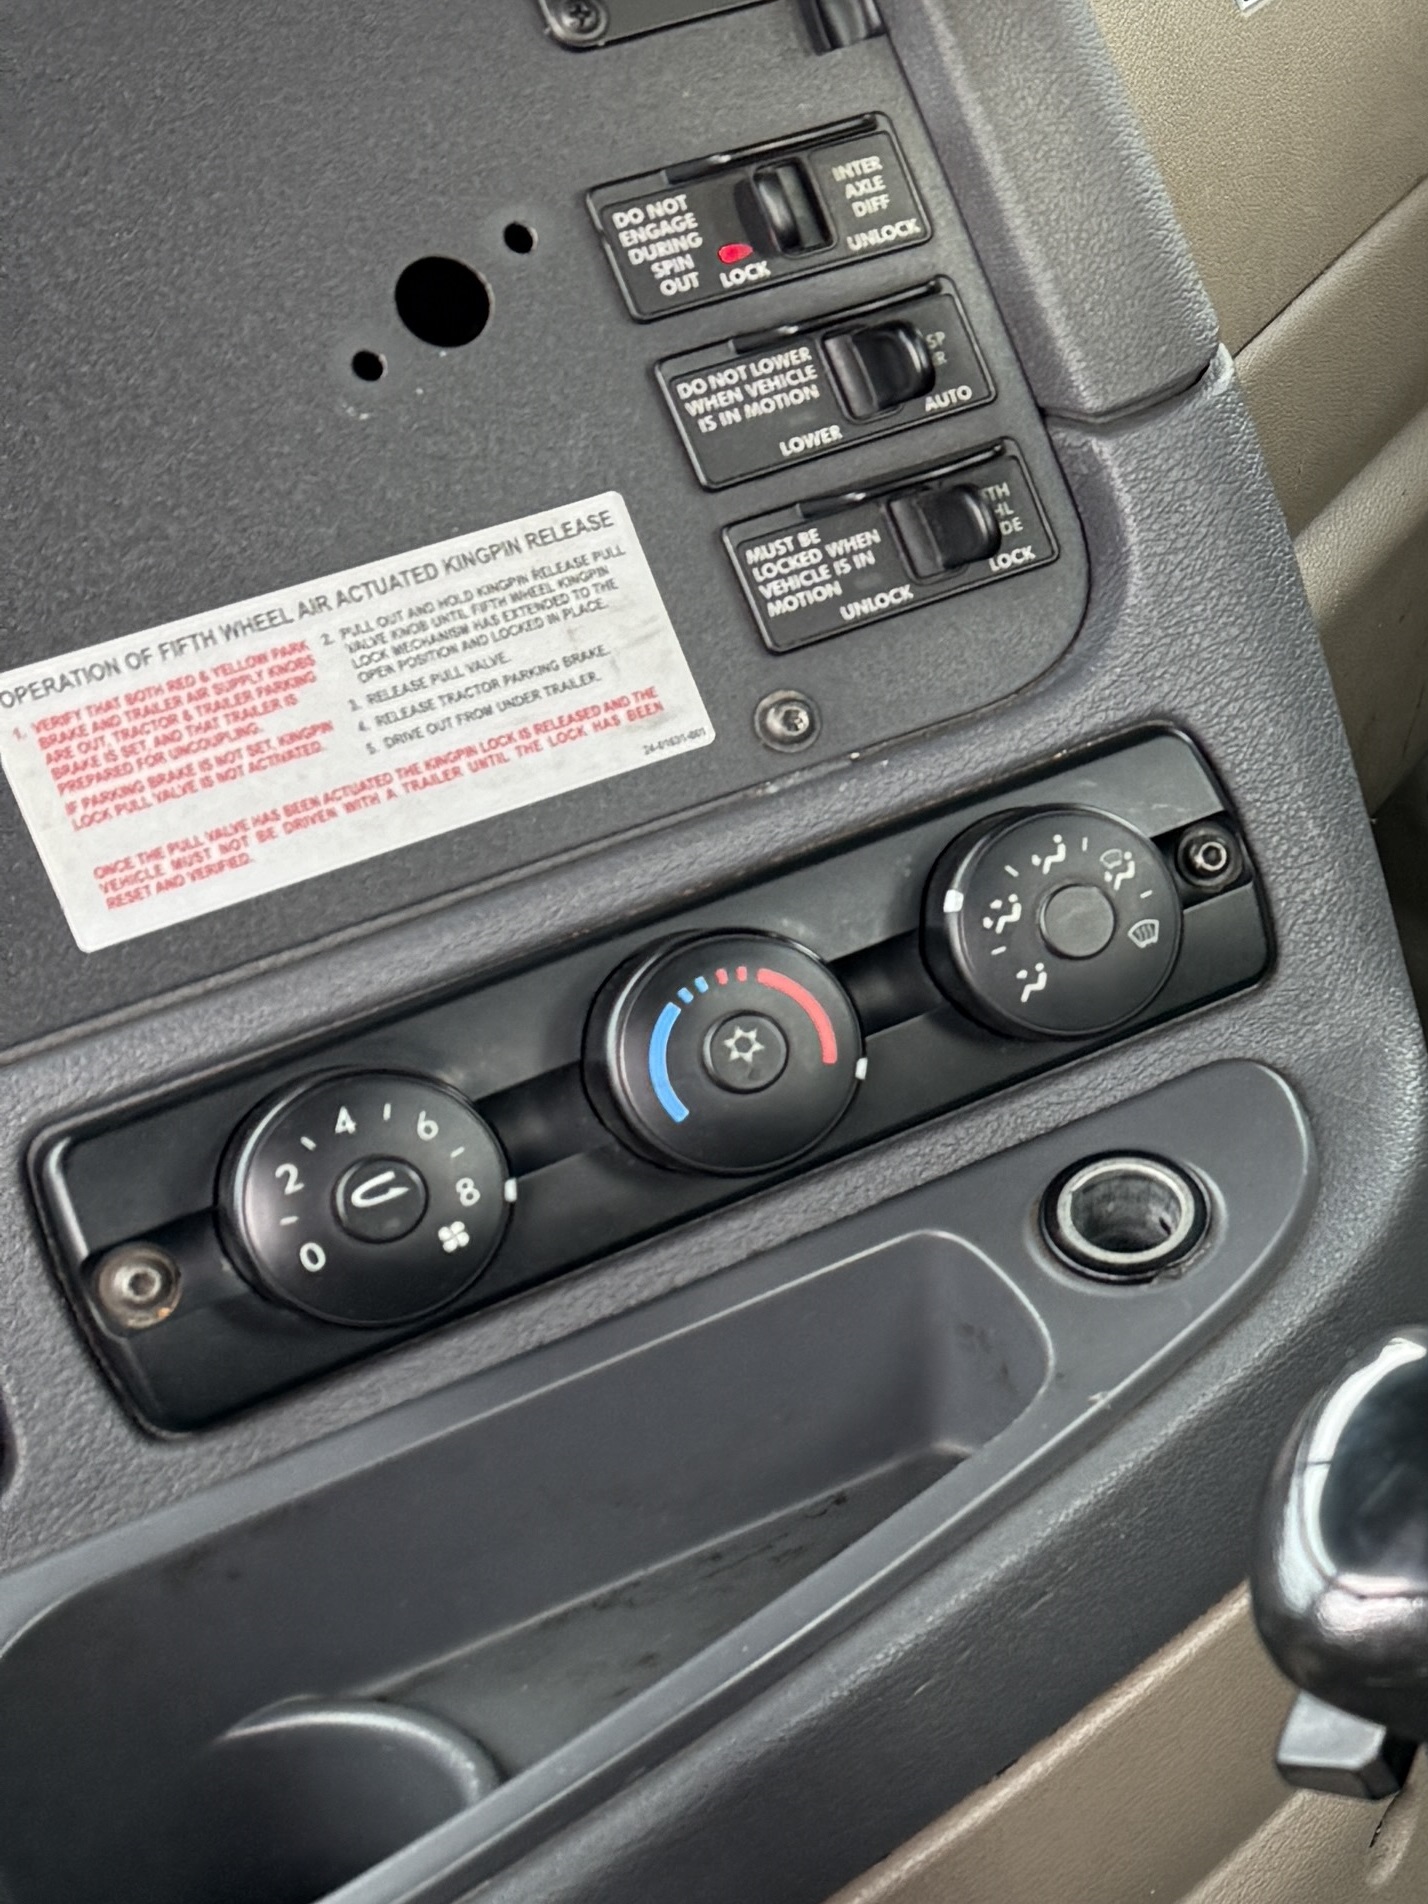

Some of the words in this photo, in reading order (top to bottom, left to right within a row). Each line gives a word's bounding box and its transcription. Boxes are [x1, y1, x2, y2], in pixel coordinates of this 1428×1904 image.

[832, 156, 882, 180] INTER
[845, 175, 885, 198] AXLE
[612, 207, 643, 227] DO
[646, 194, 687, 216] NOT
[851, 194, 889, 217] DIFF
[618, 212, 698, 246] ENGAGE
[846, 218, 920, 250] UNLOCK
[628, 232, 702, 264] DURING
[651, 255, 694, 278] SPIN
[719, 260, 770, 287] LOCK
[659, 271, 698, 295] OUT
[677, 378, 706, 397] DO
[707, 365, 745, 386] NOT
[749, 346, 811, 374] LOWER
[685, 388, 742, 415] WHEN
[745, 365, 817, 395] VEHICLE
[925, 385, 972, 411] AUTO
[697, 416, 716, 432] IS
[719, 409, 741, 426] IN
[744, 384, 819, 418] MOTION
[779, 425, 842, 455] LOWER
[745, 536, 792, 562] MUST
[797, 528, 820, 545] BE
[752, 549, 822, 580] LOCKED
[825, 529, 880, 555] WHEN
[989, 545, 1035, 571] LOCK
[759, 565, 830, 597] VEHICLE
[833, 559, 851, 574] IS
[853, 551, 875, 568] IN
[0, 658, 120, 708] OPERATION
[124, 647, 151, 669] OF
[157, 629, 217, 660] FIFTH
[218, 607, 294, 641] WHEEL
[298, 595, 332, 619] AIR
[336, 562, 438, 607] ACTUATED
[441, 537, 521, 574] KINGPIN
[524, 510, 614, 549] RELEASE
[767, 582, 842, 616] MOTION
[839, 584, 913, 619] UNLOCK
[366, 676, 428, 704] RELEASE
[429, 666, 464, 684] PULL
[374, 698, 435, 726] RELEASE
[437, 678, 500, 706] TRACTOR
[502, 659, 559, 685] PARKING
[383, 726, 424, 748] DRIVE
[426, 717, 451, 734] OUT
[455, 704, 493, 724] FROM
[496, 689, 541, 711] UNDER
[335, 1106, 357, 1134] 4
[417, 1110, 439, 1140] 6
[275, 1163, 304, 1195] 2
[456, 1177, 481, 1206] 8
[300, 1242, 326, 1272] 0
